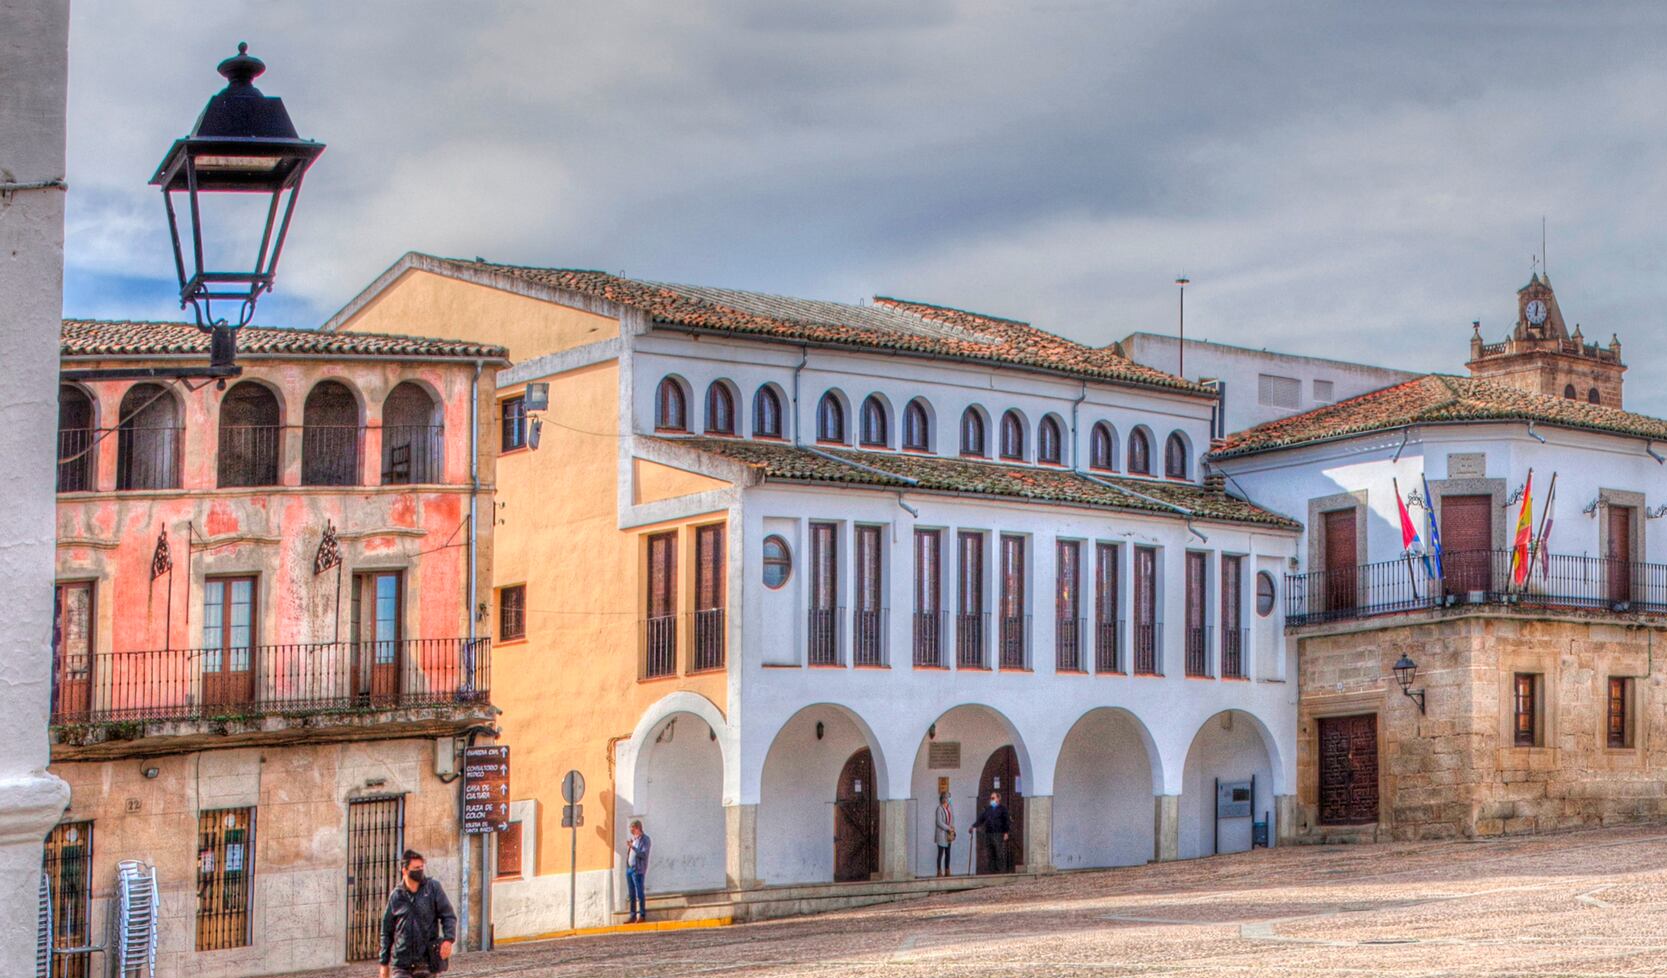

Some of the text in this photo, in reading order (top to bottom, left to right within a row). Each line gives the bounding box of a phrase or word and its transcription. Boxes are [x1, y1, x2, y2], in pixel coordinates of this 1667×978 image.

[466, 792, 490, 800] CULTURA
[128, 800, 141, 811] 22
[466, 803, 493, 812] PLAZA DE
